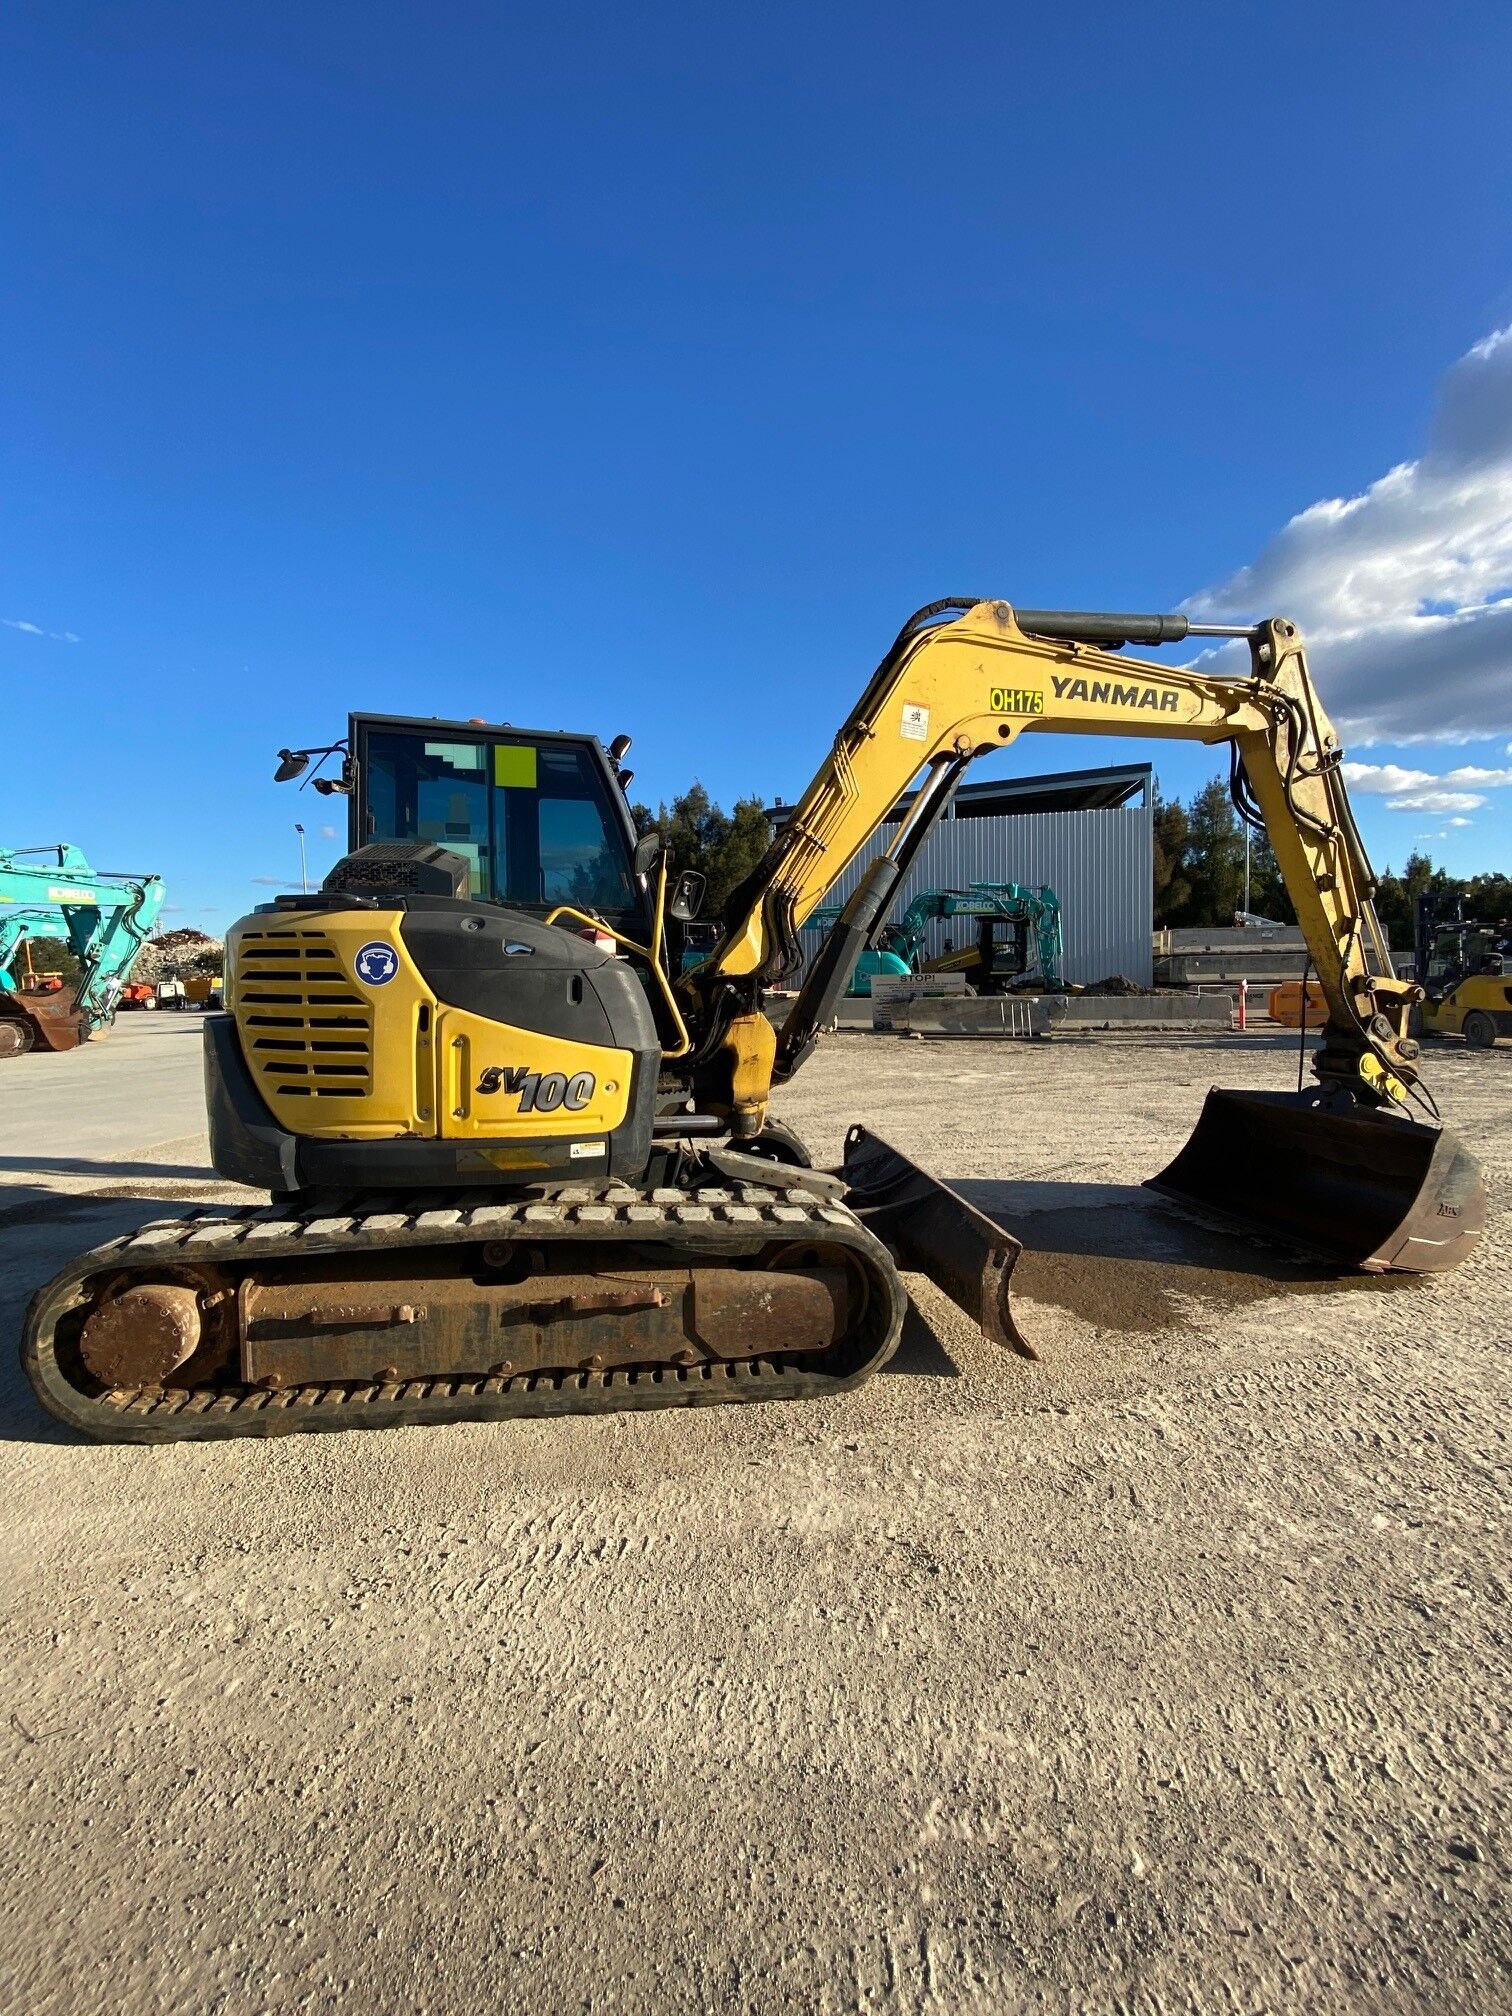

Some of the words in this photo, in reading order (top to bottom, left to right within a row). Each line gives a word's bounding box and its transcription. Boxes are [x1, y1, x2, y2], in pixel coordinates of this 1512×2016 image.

[990, 688, 1043, 714] OH175
[1051, 675, 1180, 713] YANMAR
[956, 900, 996, 910] KOBELCO
[900, 974, 935, 983] STOP!
